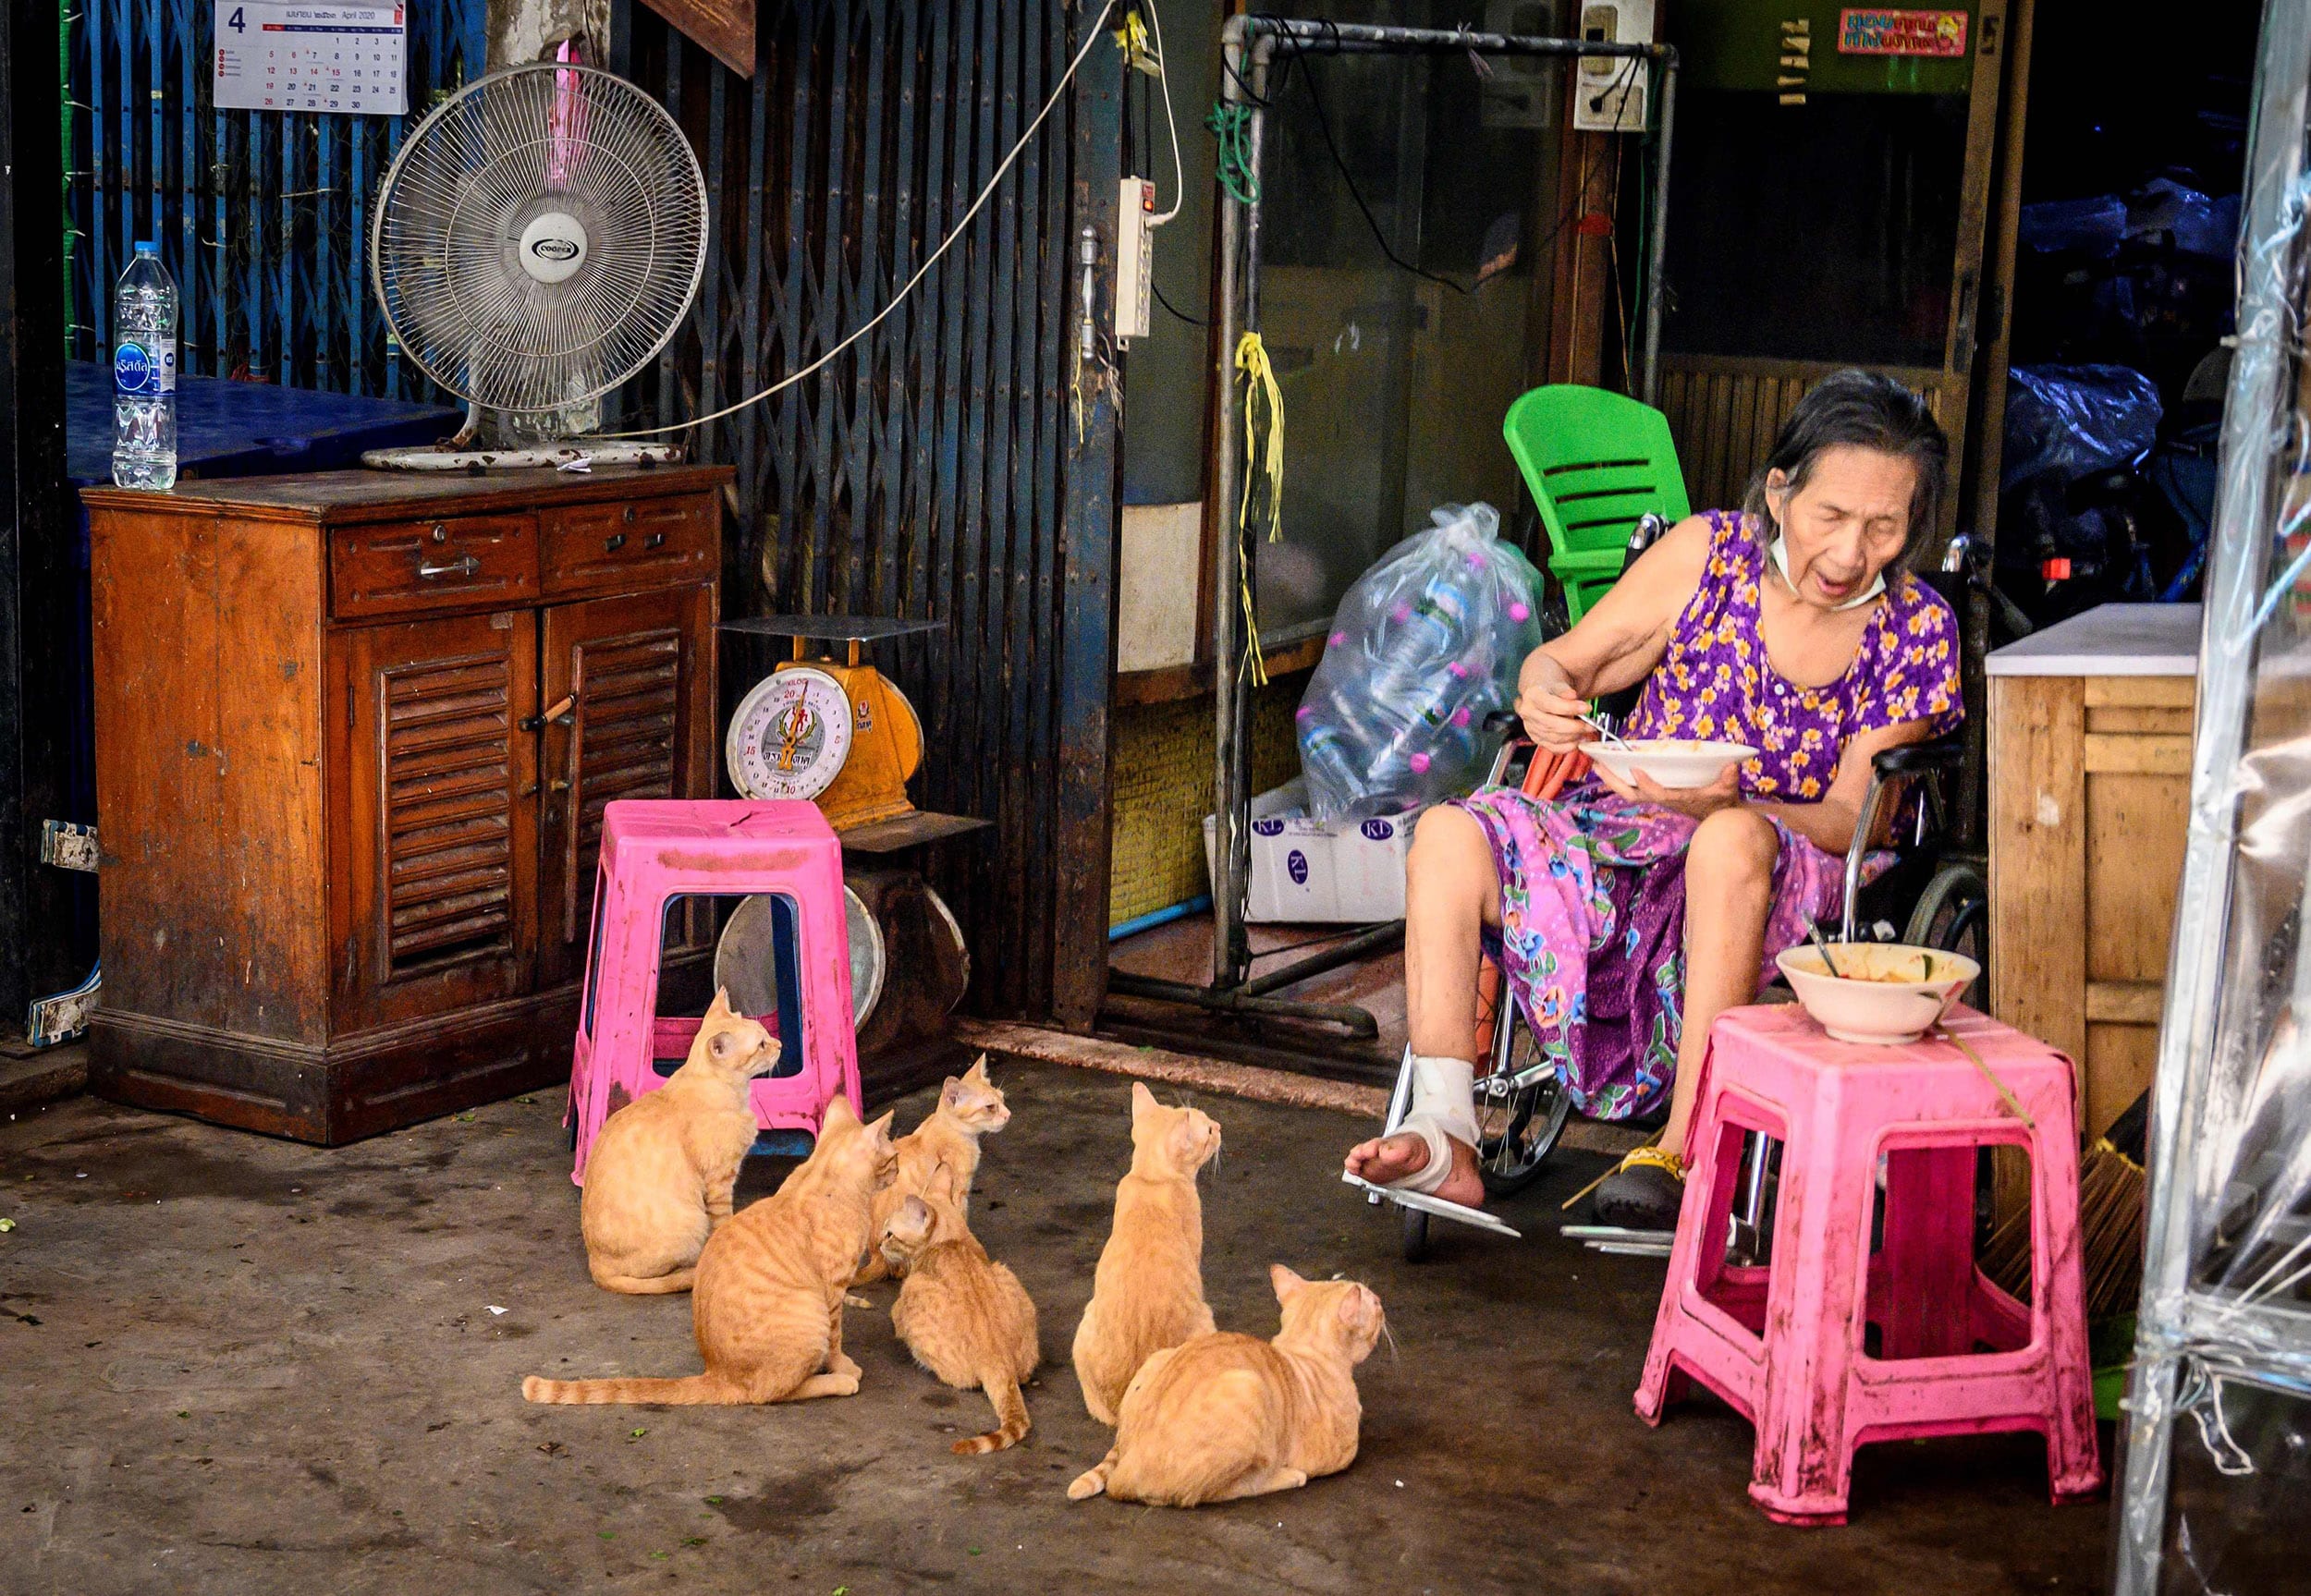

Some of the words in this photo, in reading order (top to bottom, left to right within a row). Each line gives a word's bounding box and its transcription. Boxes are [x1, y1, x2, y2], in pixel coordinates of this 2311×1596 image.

[228, 6, 246, 33] 4
[342, 11, 357, 20] April
[358, 12, 375, 20] 2020
[355, 37, 360, 45] 2
[269, 50, 275, 58] 5
[291, 51, 297, 59] 6
[312, 51, 317, 59] 7
[355, 53, 360, 61] 9
[287, 82, 297, 91] 20
[308, 83, 316, 91] 21
[330, 84, 339, 92] 22
[352, 85, 361, 93] 23
[389, 86, 396, 94] 25
[264, 97, 274, 105] 26
[287, 98, 294, 106] 27
[307, 99, 316, 107] 28
[329, 100, 338, 108] 29
[351, 101, 361, 109] 30
[784, 689, 795, 699] 20
[744, 746, 755, 756] 15
[787, 786, 796, 795] 10
